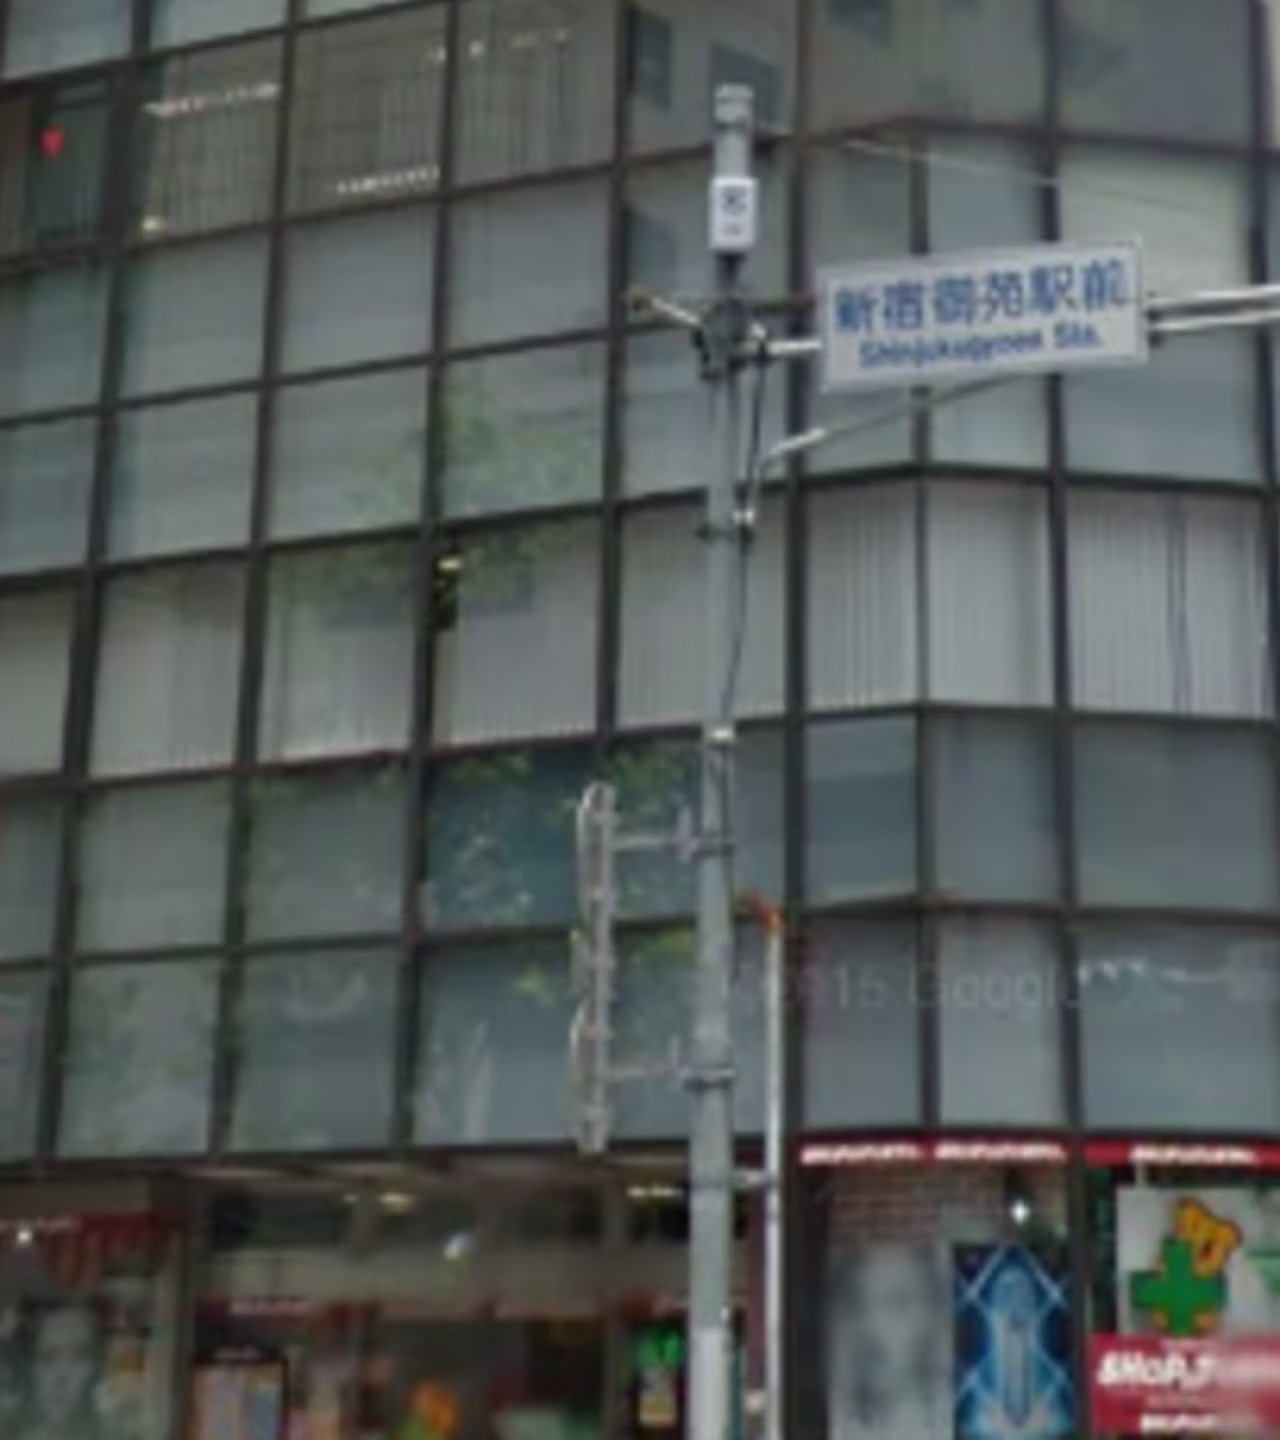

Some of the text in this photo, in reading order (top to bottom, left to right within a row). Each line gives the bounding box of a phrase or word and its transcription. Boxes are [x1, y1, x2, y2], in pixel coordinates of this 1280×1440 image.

[834, 258, 1131, 332] 新宿御苑駅前
